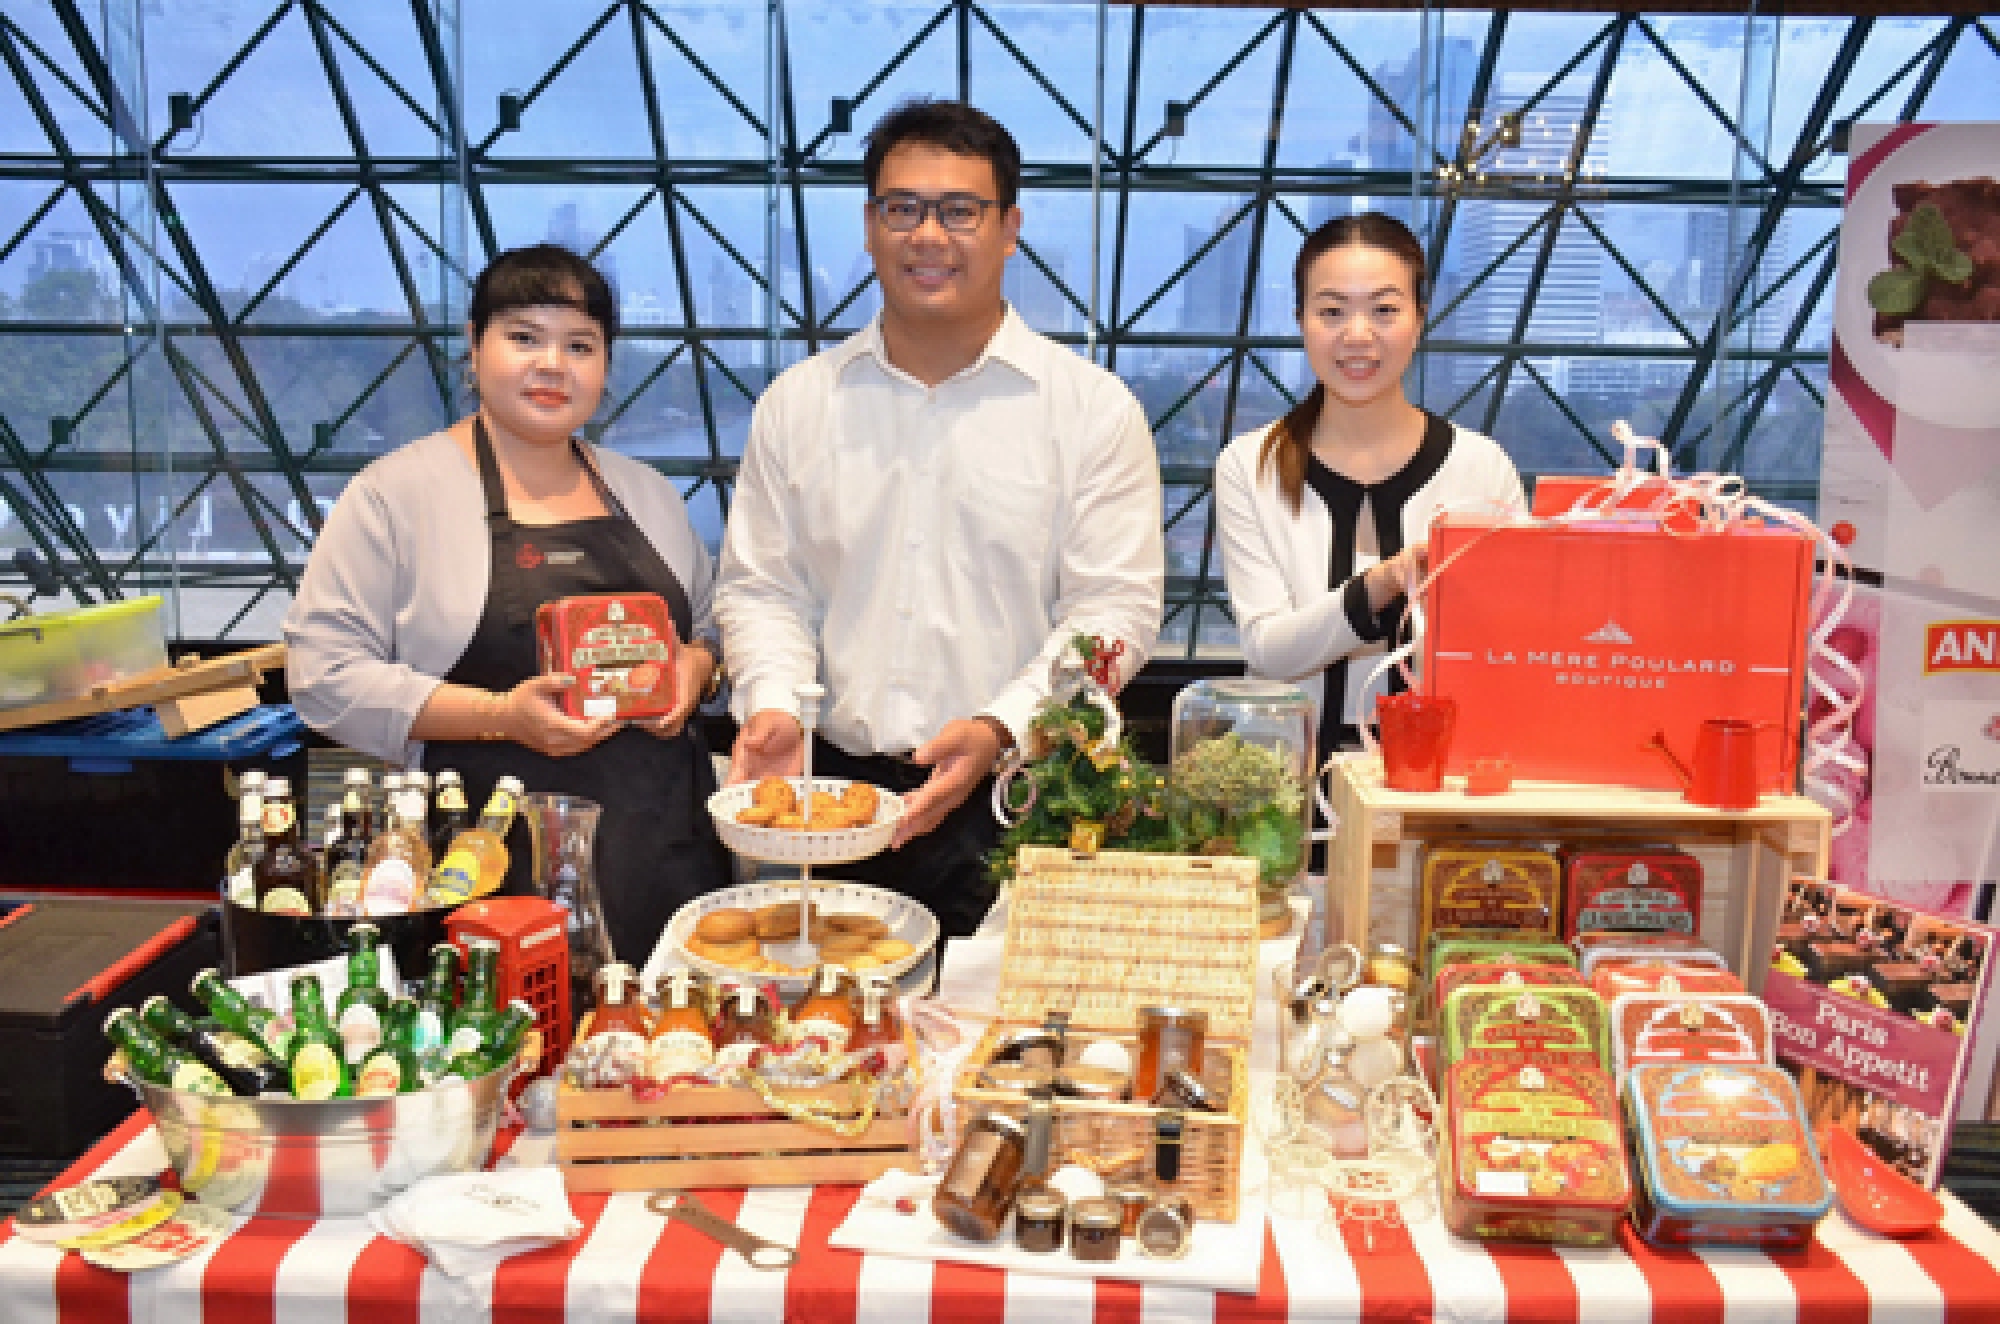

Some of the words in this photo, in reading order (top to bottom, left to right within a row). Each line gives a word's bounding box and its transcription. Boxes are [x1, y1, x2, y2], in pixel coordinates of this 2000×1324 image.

[1486, 649, 1517, 665] LA
[1609, 653, 1736, 677] POULARD
[1932, 631, 2000, 665] AN
[1769, 1010, 1818, 1049] Bon
[1815, 1000, 1889, 1049] Paris
